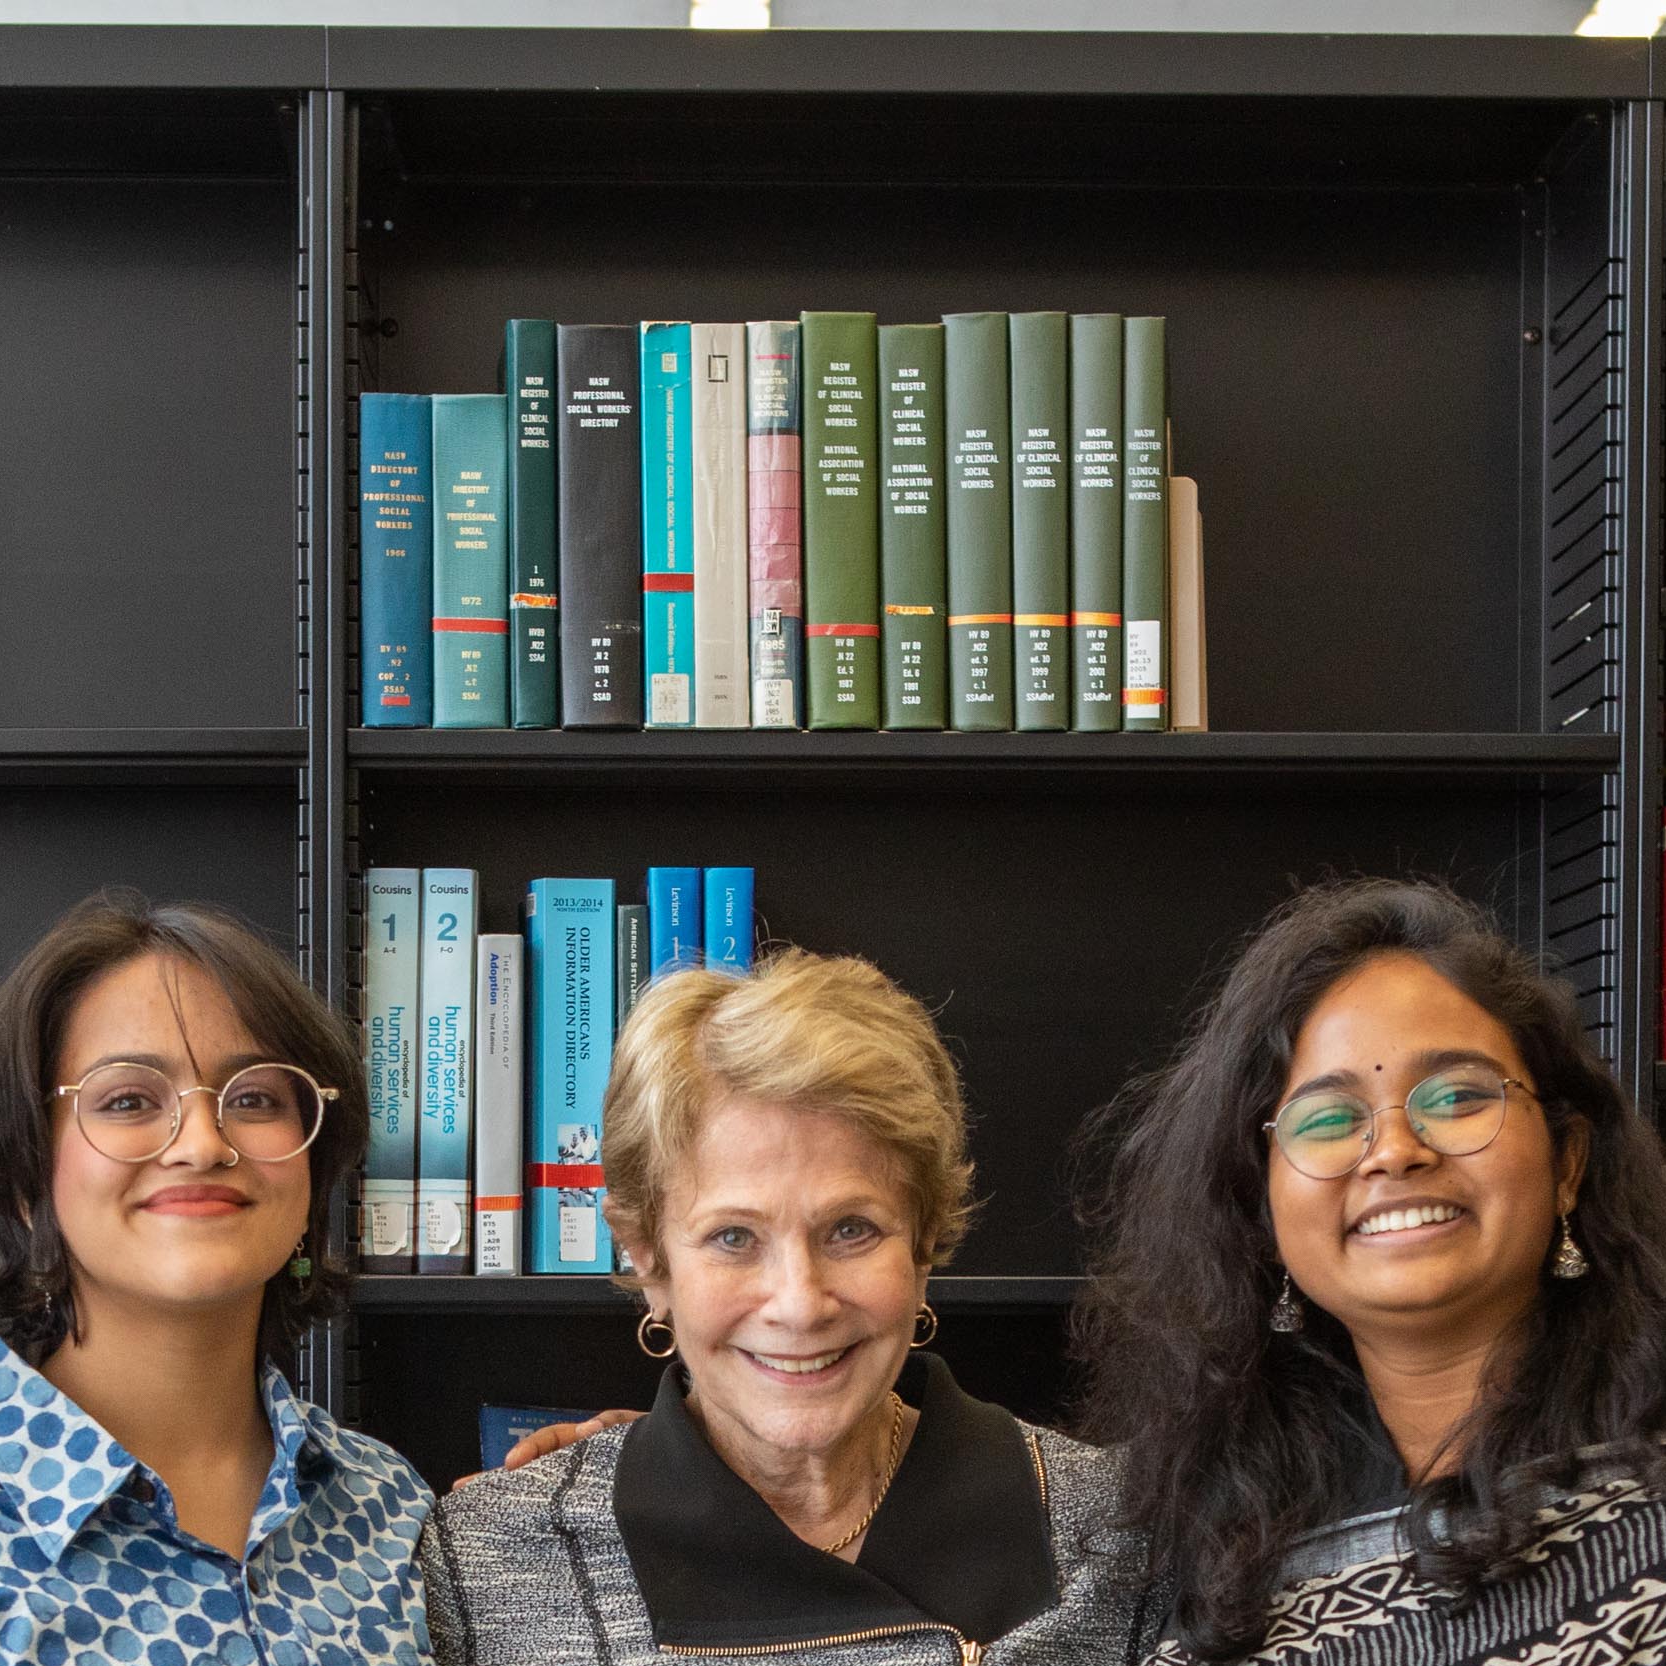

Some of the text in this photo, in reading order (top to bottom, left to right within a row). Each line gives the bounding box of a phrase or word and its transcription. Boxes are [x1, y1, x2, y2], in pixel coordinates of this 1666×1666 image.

[830, 362, 851, 372] NASW
[589, 378, 609, 386] NASW
[823, 376, 857, 385] REGISTER
[573, 391, 625, 400] PROFESSIONAL
[817, 390, 863, 399] OF CLINICAL
[567, 405, 593, 414] SOCIAL
[828, 404, 853, 413] SOCIAL
[581, 418, 619, 428] DIRECTORY
[825, 418, 857, 427] WORKERS
[824, 446, 859, 454] NATIONAL
[819, 460, 864, 468] ASSOCIATION
[823, 473, 861, 482] OF SOCIAL
[825, 487, 859, 496] WORKERS
[971, 668, 987, 677] 1997
[373, 885, 412, 896] Cousins
[429, 885, 469, 895] Cousins
[553, 898, 603, 908] 2013/2014
[382, 913, 395, 941] 1
[437, 912, 457, 940] 2
[723, 936, 736, 960] 2
[489, 952, 499, 1005] Adoption
[579, 927, 591, 1060] OLDER AMERICANS
[565, 927, 577, 1109] INFORMATION DIRECTORY
[370, 1016, 384, 1120] and diversity
[387, 1006, 405, 1134] human services
[423, 1017, 443, 1119] and diversity
[443, 1006, 462, 1134] human services
